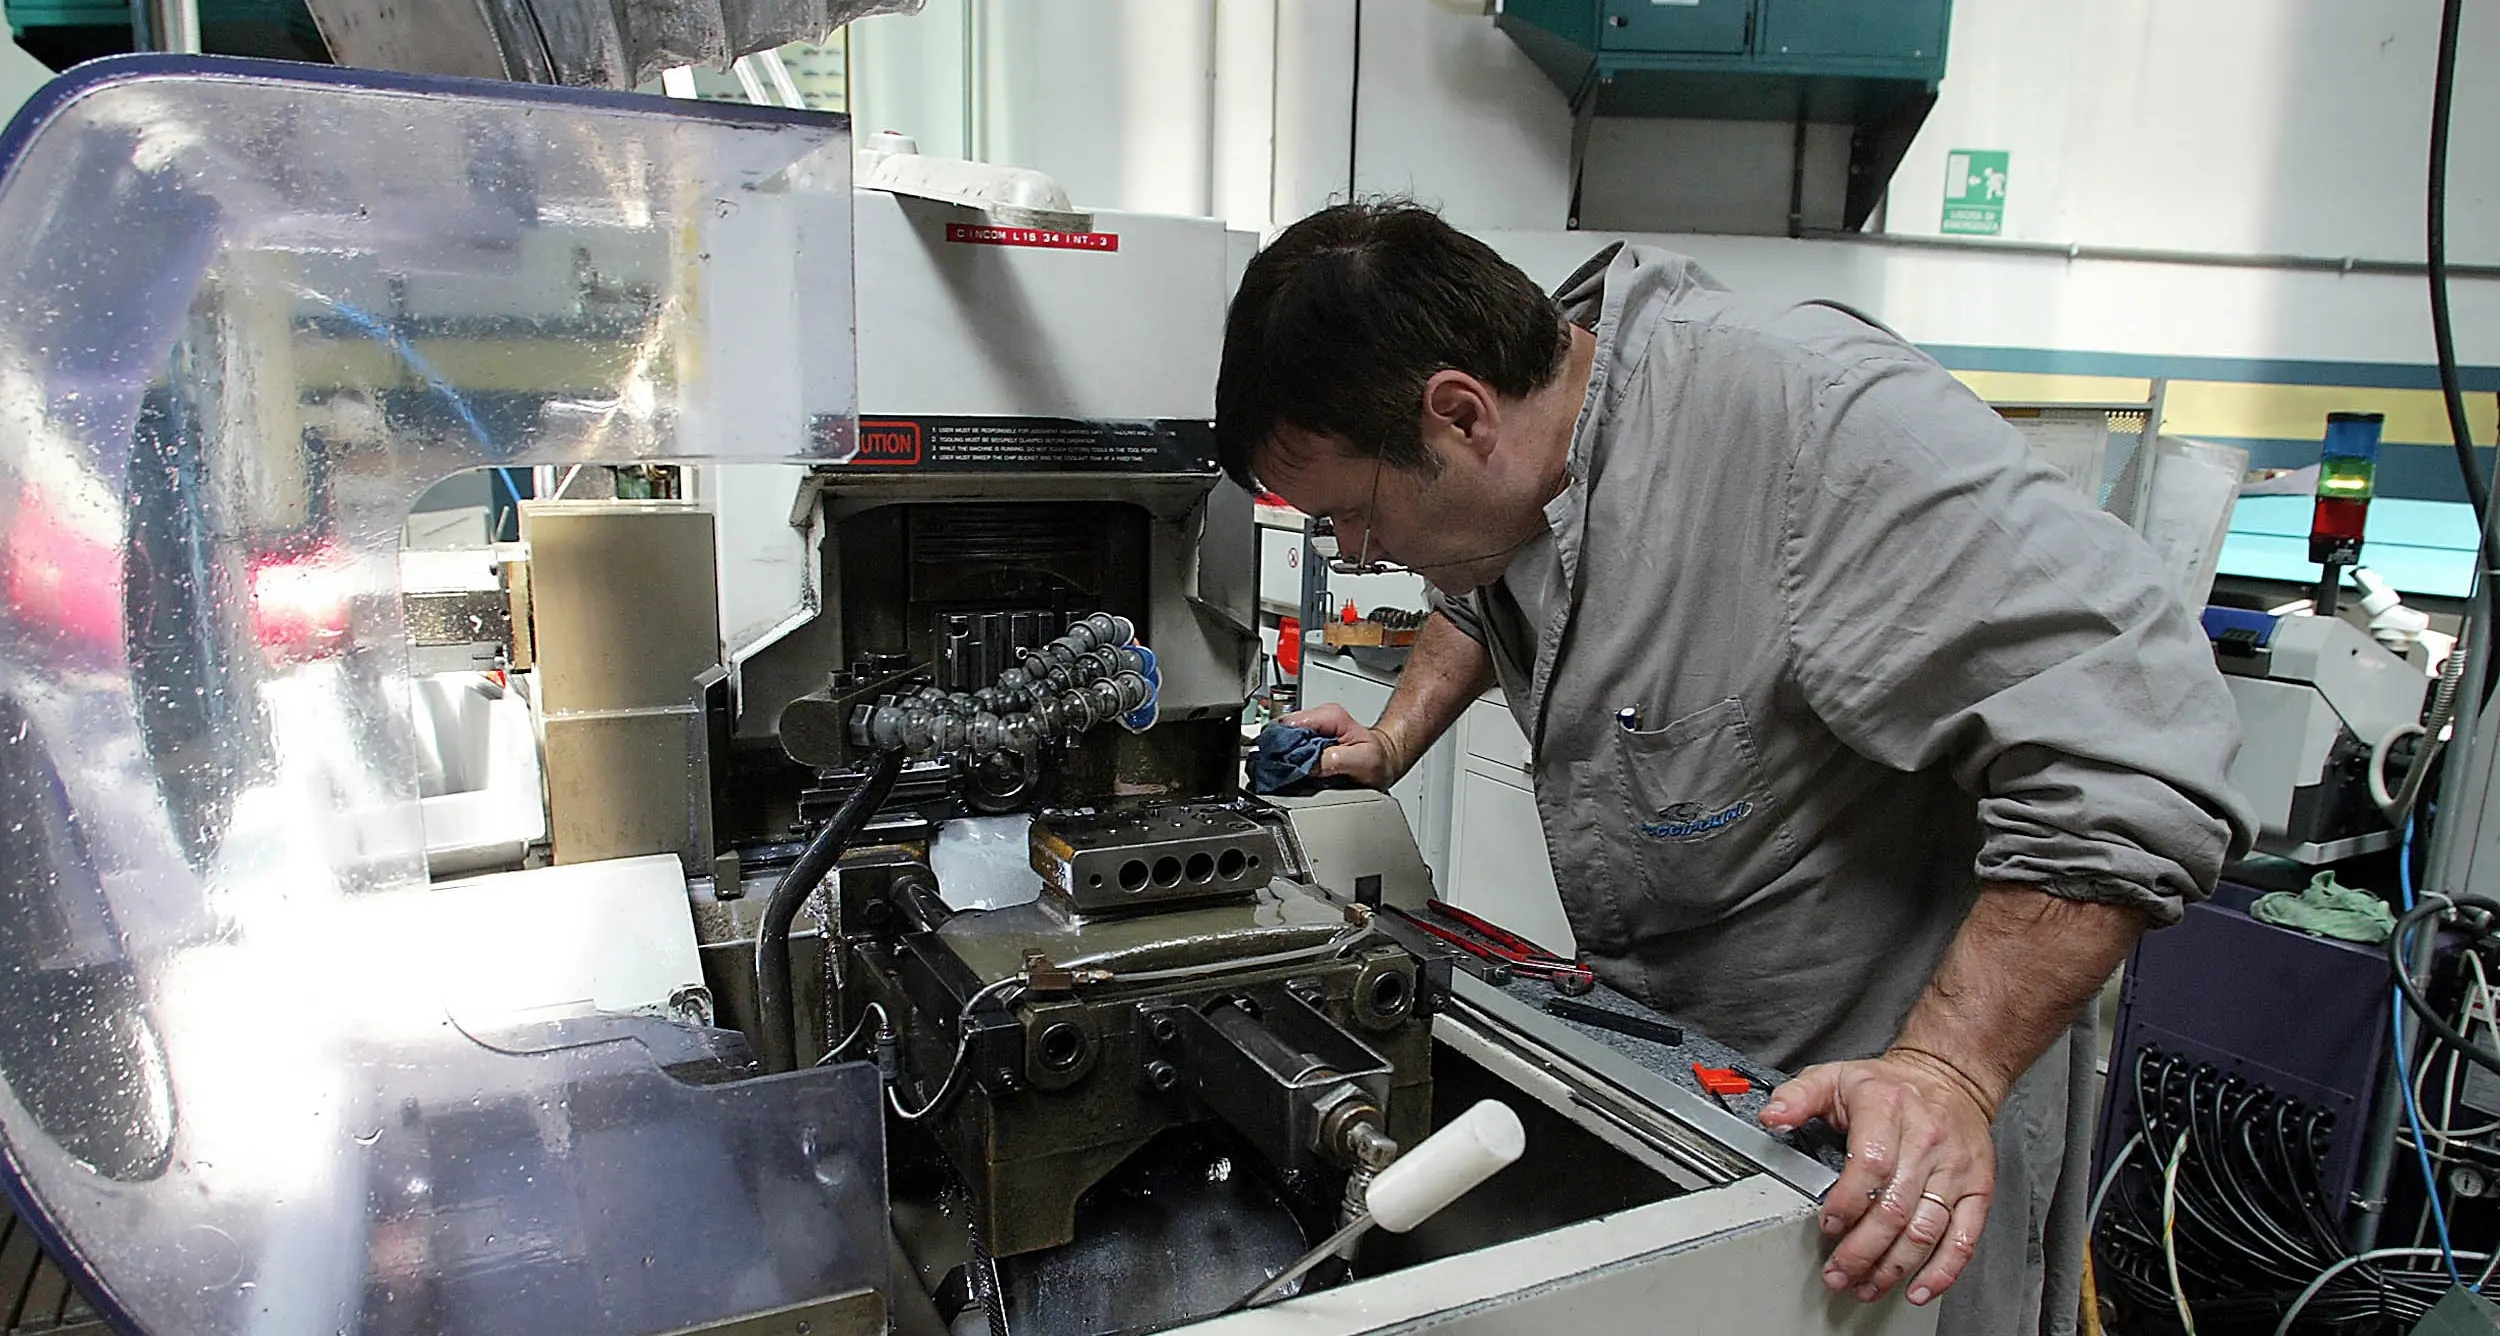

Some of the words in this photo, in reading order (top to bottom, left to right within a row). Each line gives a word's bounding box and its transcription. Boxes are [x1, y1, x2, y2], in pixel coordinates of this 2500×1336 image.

[1043, 233, 1059, 243] 34
[1100, 237, 1107, 246] 3
[860, 432, 912, 455] UTION
